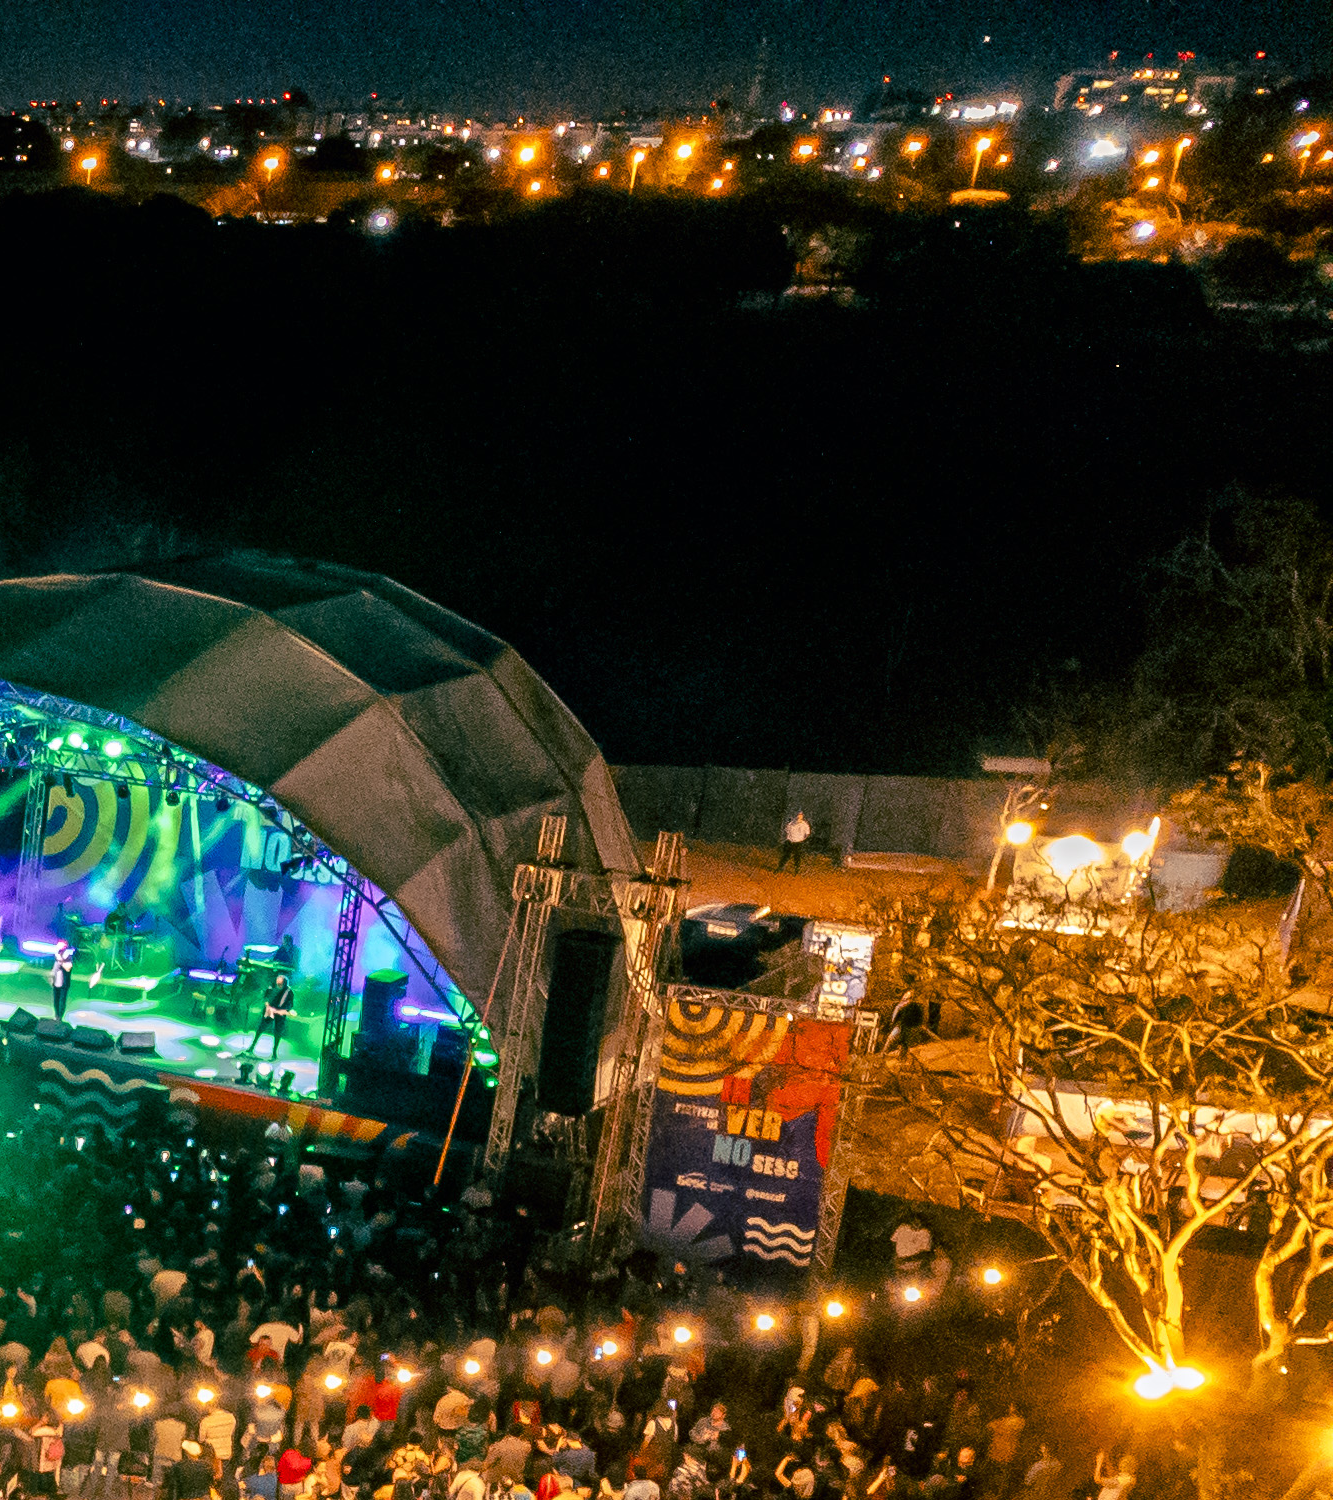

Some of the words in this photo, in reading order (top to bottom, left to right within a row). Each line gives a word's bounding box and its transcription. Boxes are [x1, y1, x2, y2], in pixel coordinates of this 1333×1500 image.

[726, 1105, 783, 1142] VER
[712, 1134, 751, 1167] NO
[752, 1154, 799, 1180] SESC
